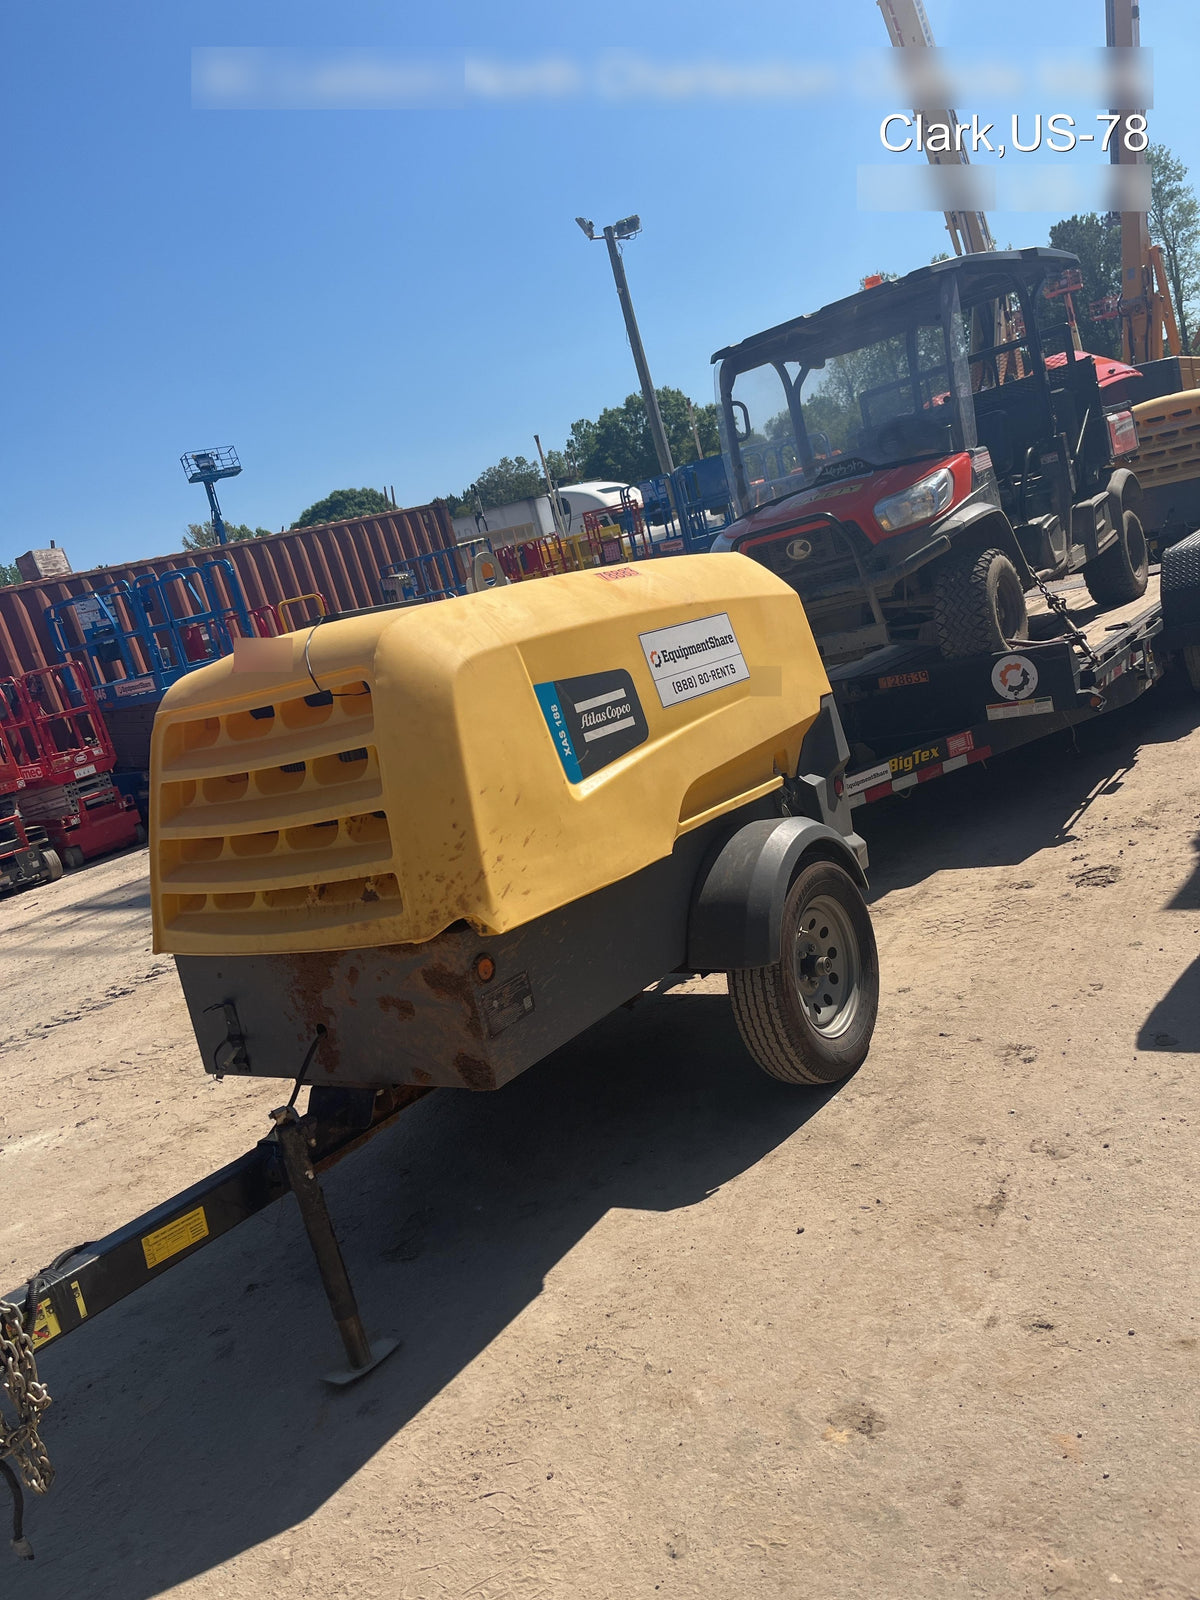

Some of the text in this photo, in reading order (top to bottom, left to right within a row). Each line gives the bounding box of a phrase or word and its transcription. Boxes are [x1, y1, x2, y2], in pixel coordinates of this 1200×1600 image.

[661, 633, 735, 664] EquipmentShare
[672, 663, 736, 694] (888) 80-RENTS
[883, 671, 929, 688] 128639
[550, 704, 572, 756] XAS 188
[581, 703, 631, 729] Atlas Copco
[22, 768, 43, 779] mec
